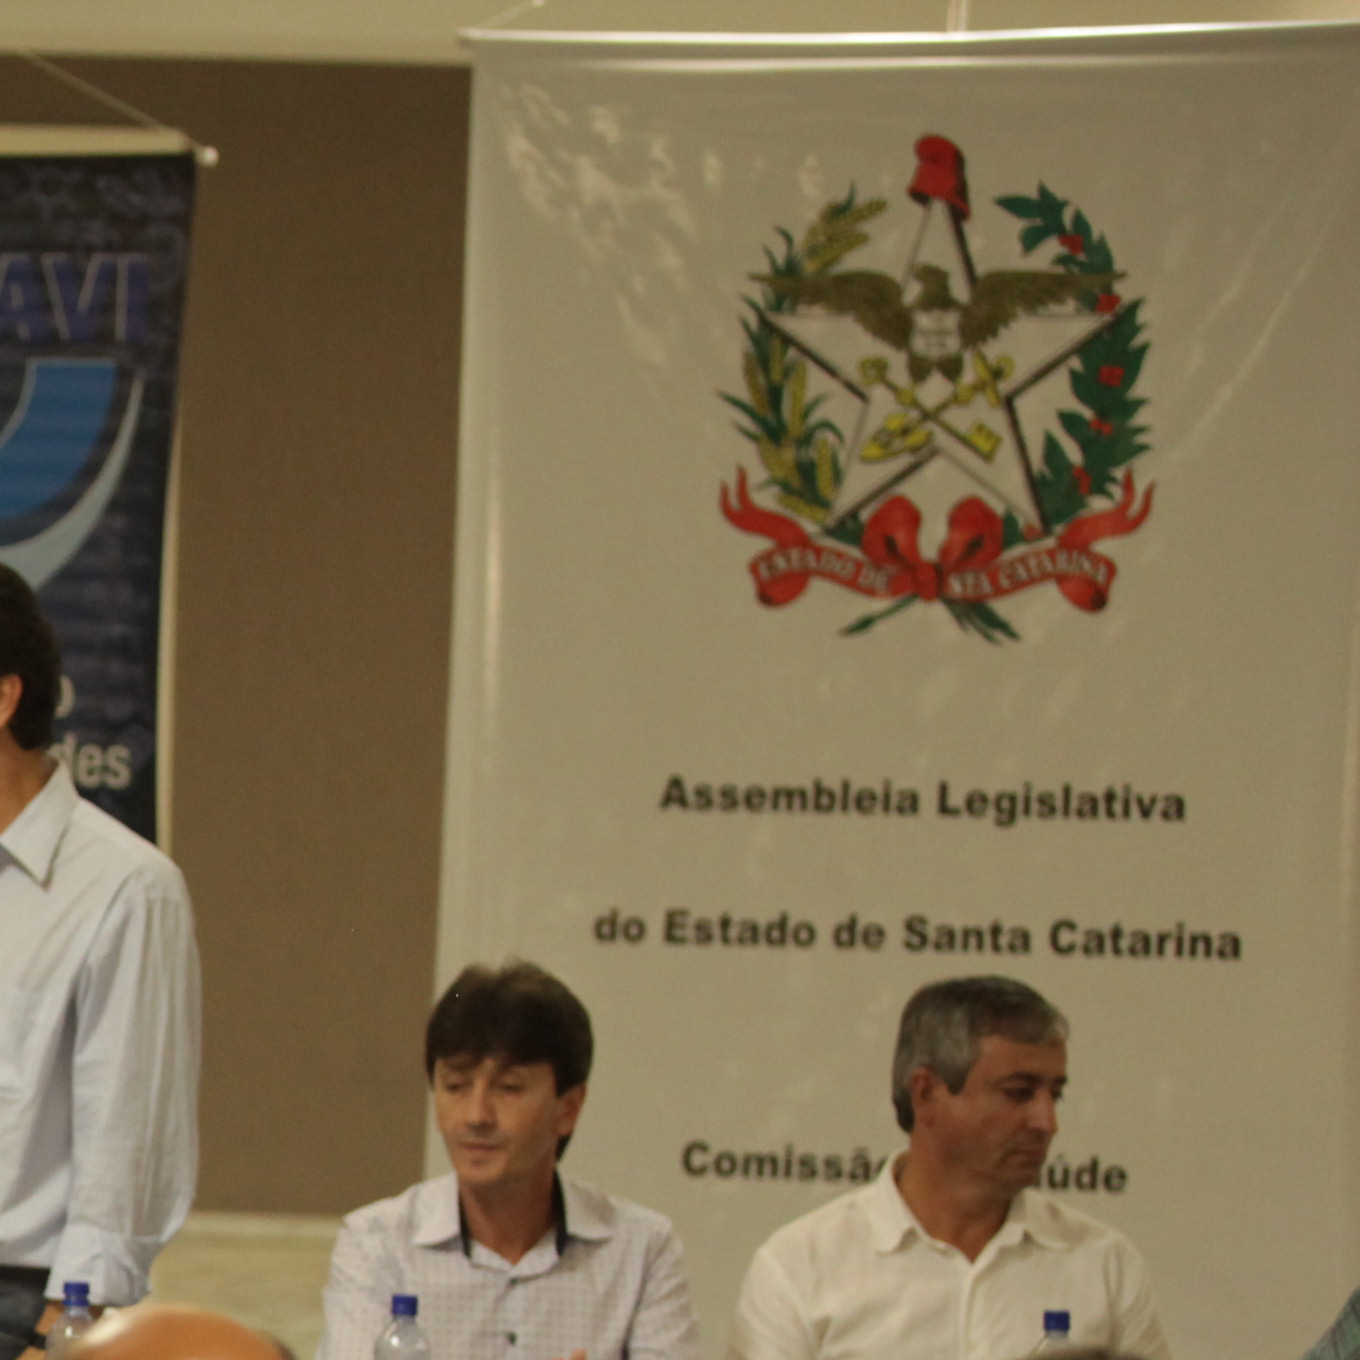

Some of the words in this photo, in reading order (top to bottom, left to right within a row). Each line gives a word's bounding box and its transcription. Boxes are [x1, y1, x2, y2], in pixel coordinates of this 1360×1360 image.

[660, 774, 920, 816] Assembleia
[936, 780, 1187, 828] Legislativa
[593, 908, 646, 945] do
[663, 908, 817, 950] Estado
[832, 913, 887, 951] de
[902, 914, 1033, 956] Santa
[1049, 919, 1243, 962] Catarina
